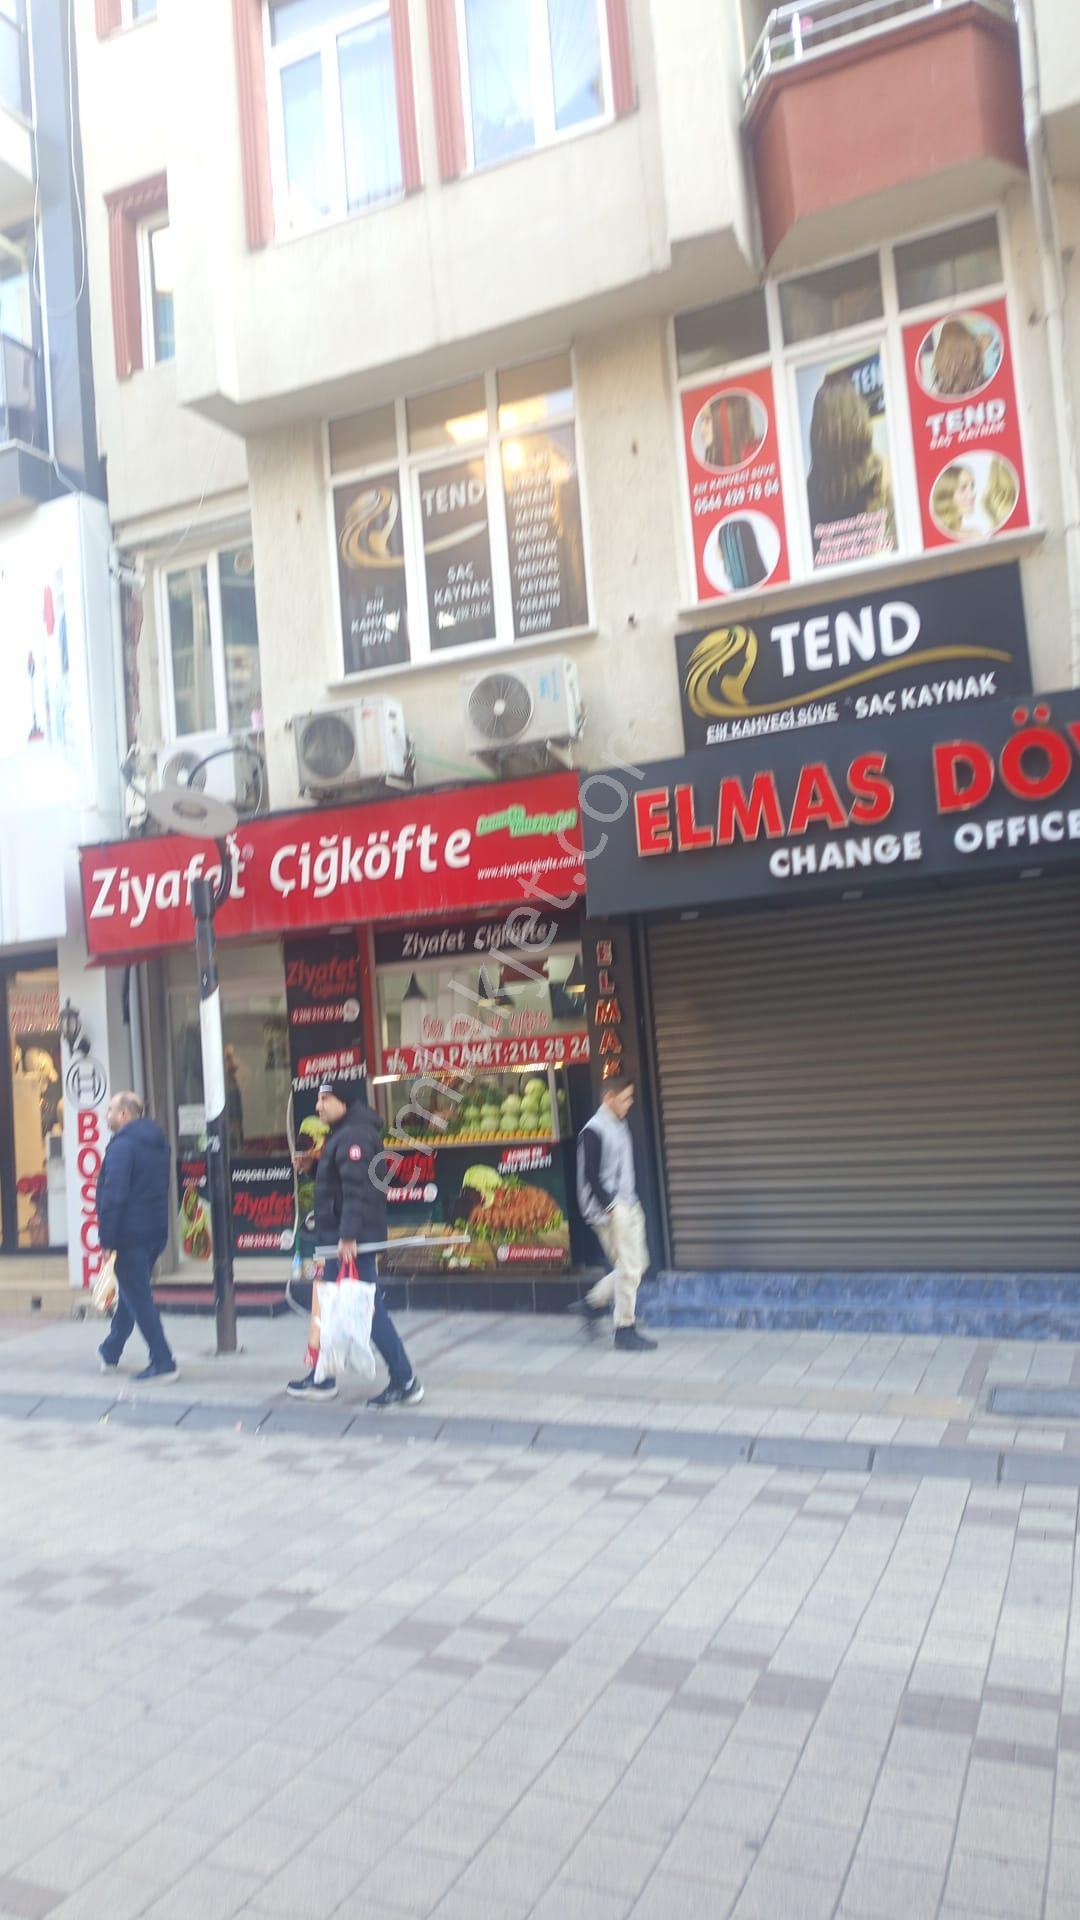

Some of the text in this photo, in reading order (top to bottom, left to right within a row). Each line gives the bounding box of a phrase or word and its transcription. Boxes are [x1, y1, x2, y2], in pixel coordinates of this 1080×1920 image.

[925, 398, 1006, 437] TEND
[422, 479, 485, 518] TEND
[434, 579, 491, 607] KAYNAK
[770, 600, 921, 678] TEND
[854, 690, 897, 719] SAÇ
[901, 671, 997, 710] KAYNAK
[634, 751, 895, 857] ELMAS
[269, 825, 471, 897] Çiğköfte
[769, 831, 922, 877] CHANGE
[402, 928, 465, 959] Ziyafet
[287, 956, 357, 992] Ziyafet
[543, 1037, 565, 1062] 25
[570, 1034, 589, 1059] 24
[77, 1109, 102, 1289] BOSCH
